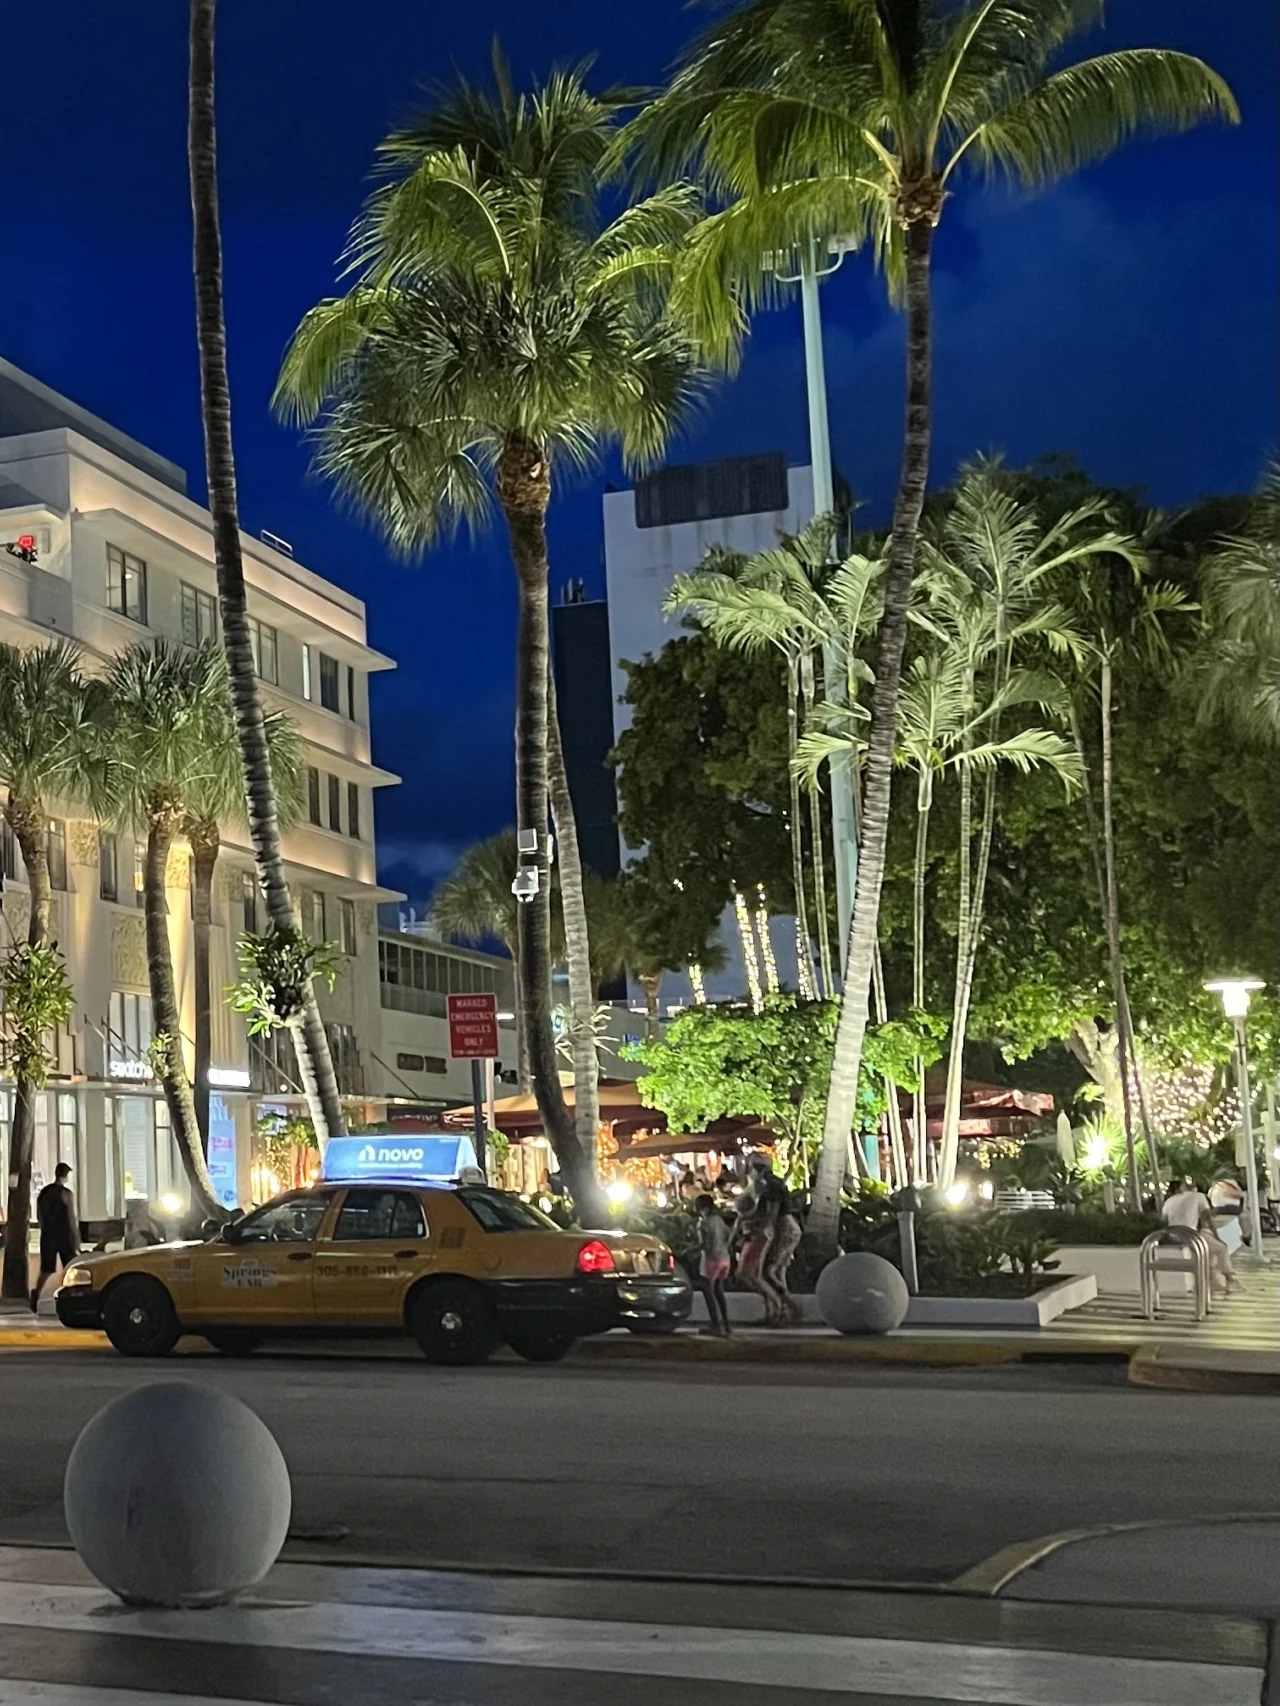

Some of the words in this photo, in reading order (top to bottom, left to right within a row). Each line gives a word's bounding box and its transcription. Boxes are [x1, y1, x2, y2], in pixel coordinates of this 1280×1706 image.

[451, 1012, 494, 1021] EMERGENCY
[455, 1024, 491, 1034] VEHICLES
[464, 1037, 483, 1047] ONLY
[378, 1148, 423, 1162] novo
